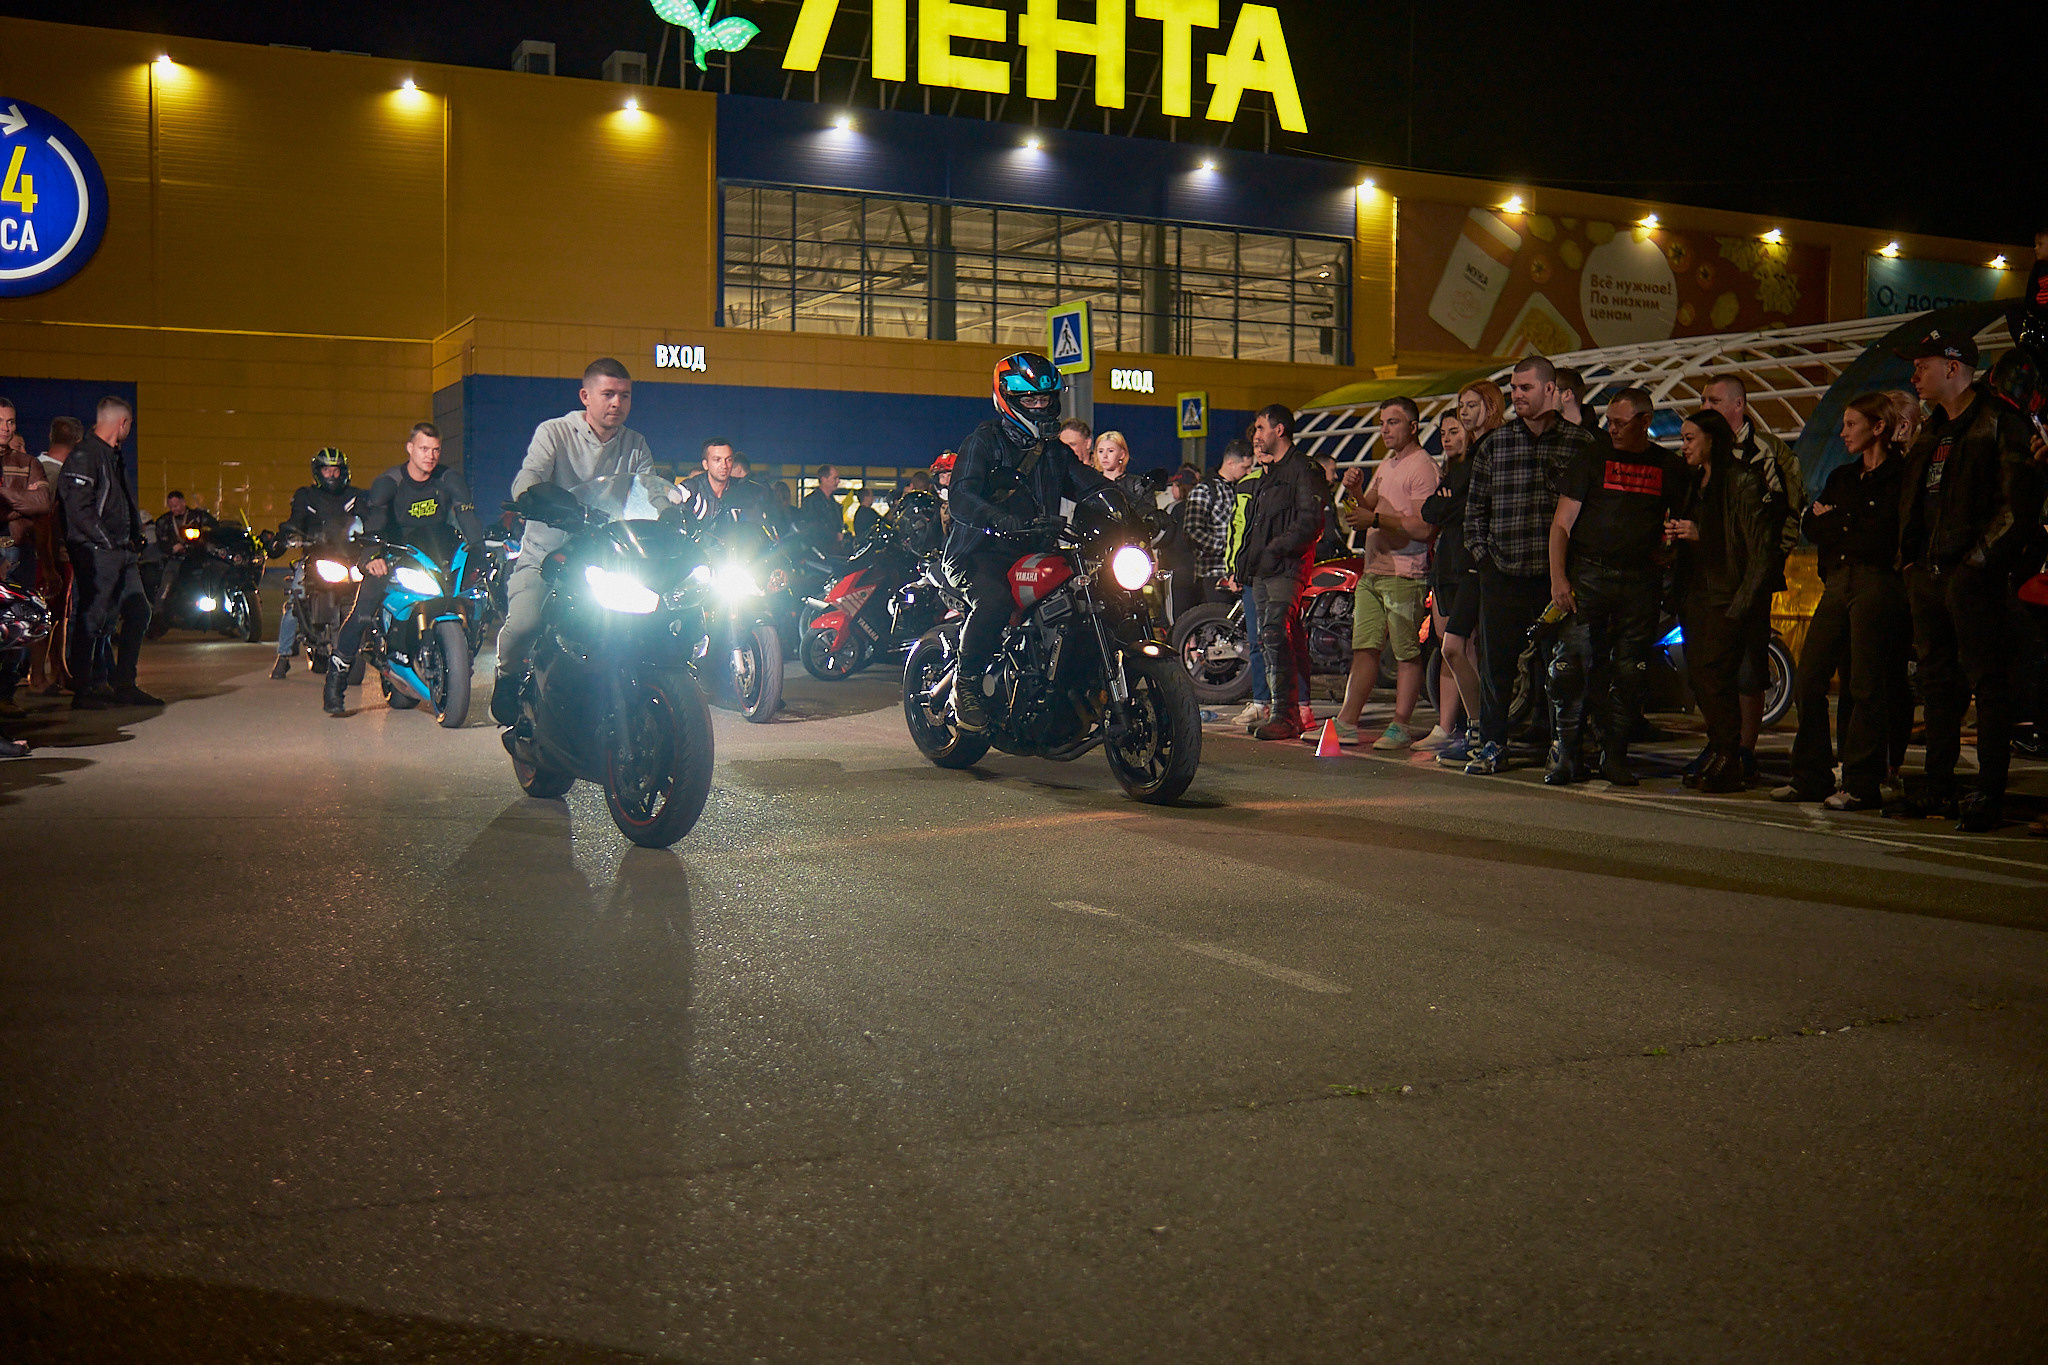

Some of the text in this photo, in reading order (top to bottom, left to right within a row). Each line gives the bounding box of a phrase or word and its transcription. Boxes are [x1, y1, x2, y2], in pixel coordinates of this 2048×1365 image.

[781, 0, 1308, 133] ЛЕНТА
[1590, 273, 1672, 296] Всё нужное!
[1590, 290, 1660, 310] По низким
[1590, 308, 1633, 321] ценам
[656, 344, 707, 373] ВХОД
[1111, 368, 1155, 394] ВХОД
[1015, 571, 1038, 582] YAMAHA
[857, 616, 880, 642] YAMAHA
